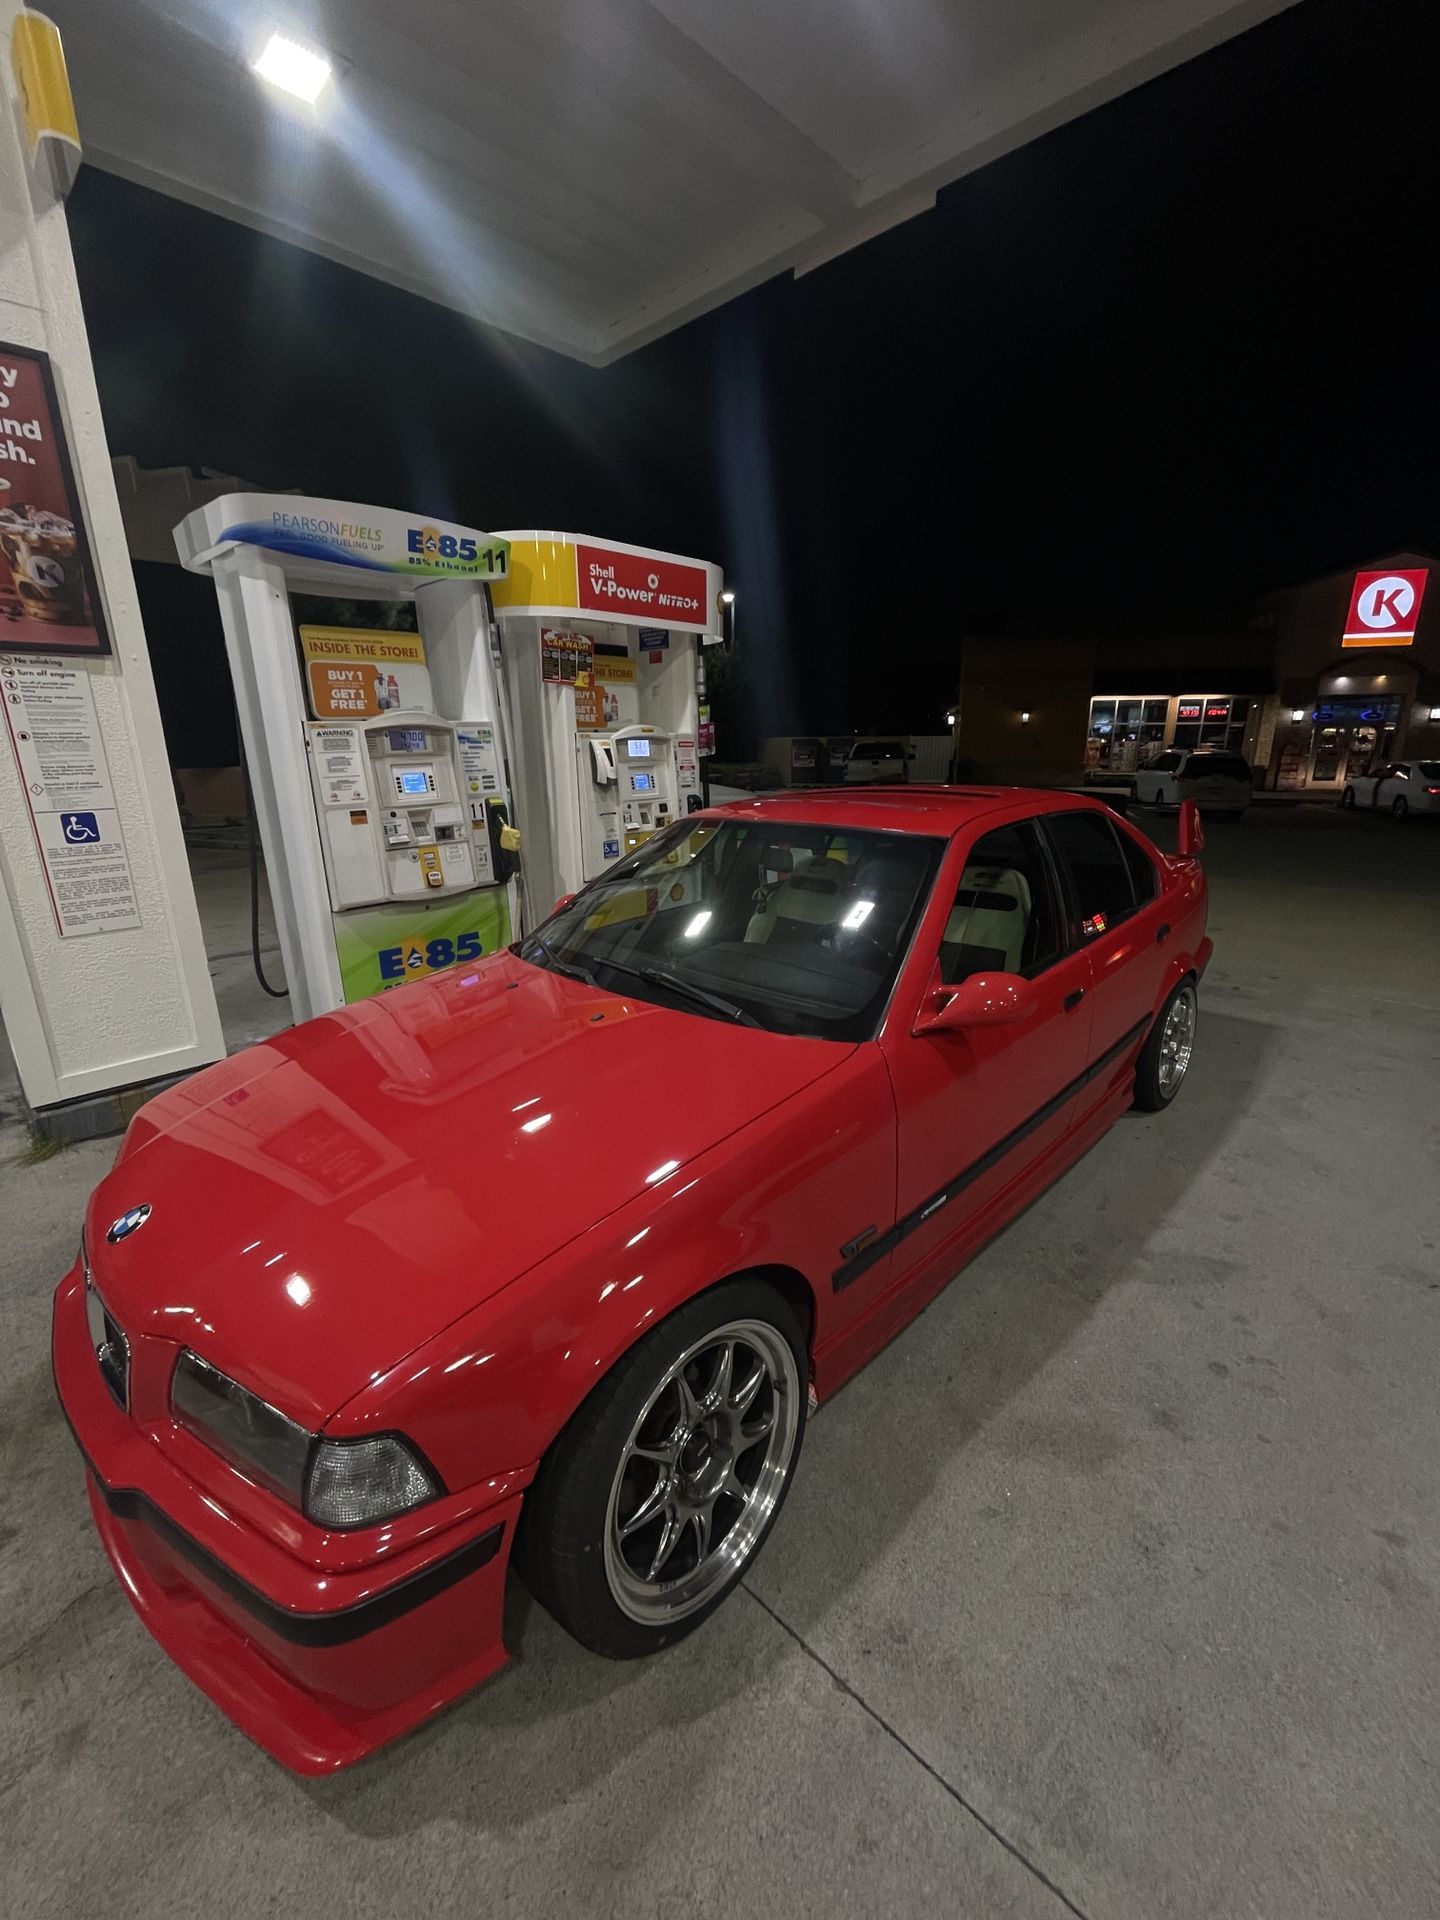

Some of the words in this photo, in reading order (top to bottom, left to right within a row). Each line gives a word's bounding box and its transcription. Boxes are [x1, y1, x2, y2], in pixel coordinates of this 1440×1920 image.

[0, 417, 42, 441] nd
[331, 538, 369, 550] FUELING
[409, 557, 430, 566] 85%
[435, 561, 478, 572] Ethanol
[483, 549, 506, 573] 11
[590, 563, 614, 579] Shell
[590, 577, 654, 603] V-Power
[1372, 589, 1404, 622] K
[309, 641, 351, 654] INSIDE
[354, 644, 377, 656] THE
[380, 646, 418, 658] STORE!
[547, 639, 563, 647] CAR
[565, 640, 588, 650] WASH
[30, 658, 63, 667] smoking
[328, 670, 354, 680] BUY
[356, 671, 363, 681] 1
[332, 689, 357, 699] GET
[358, 689, 365, 699] 1
[471, 802, 485, 818] 11
